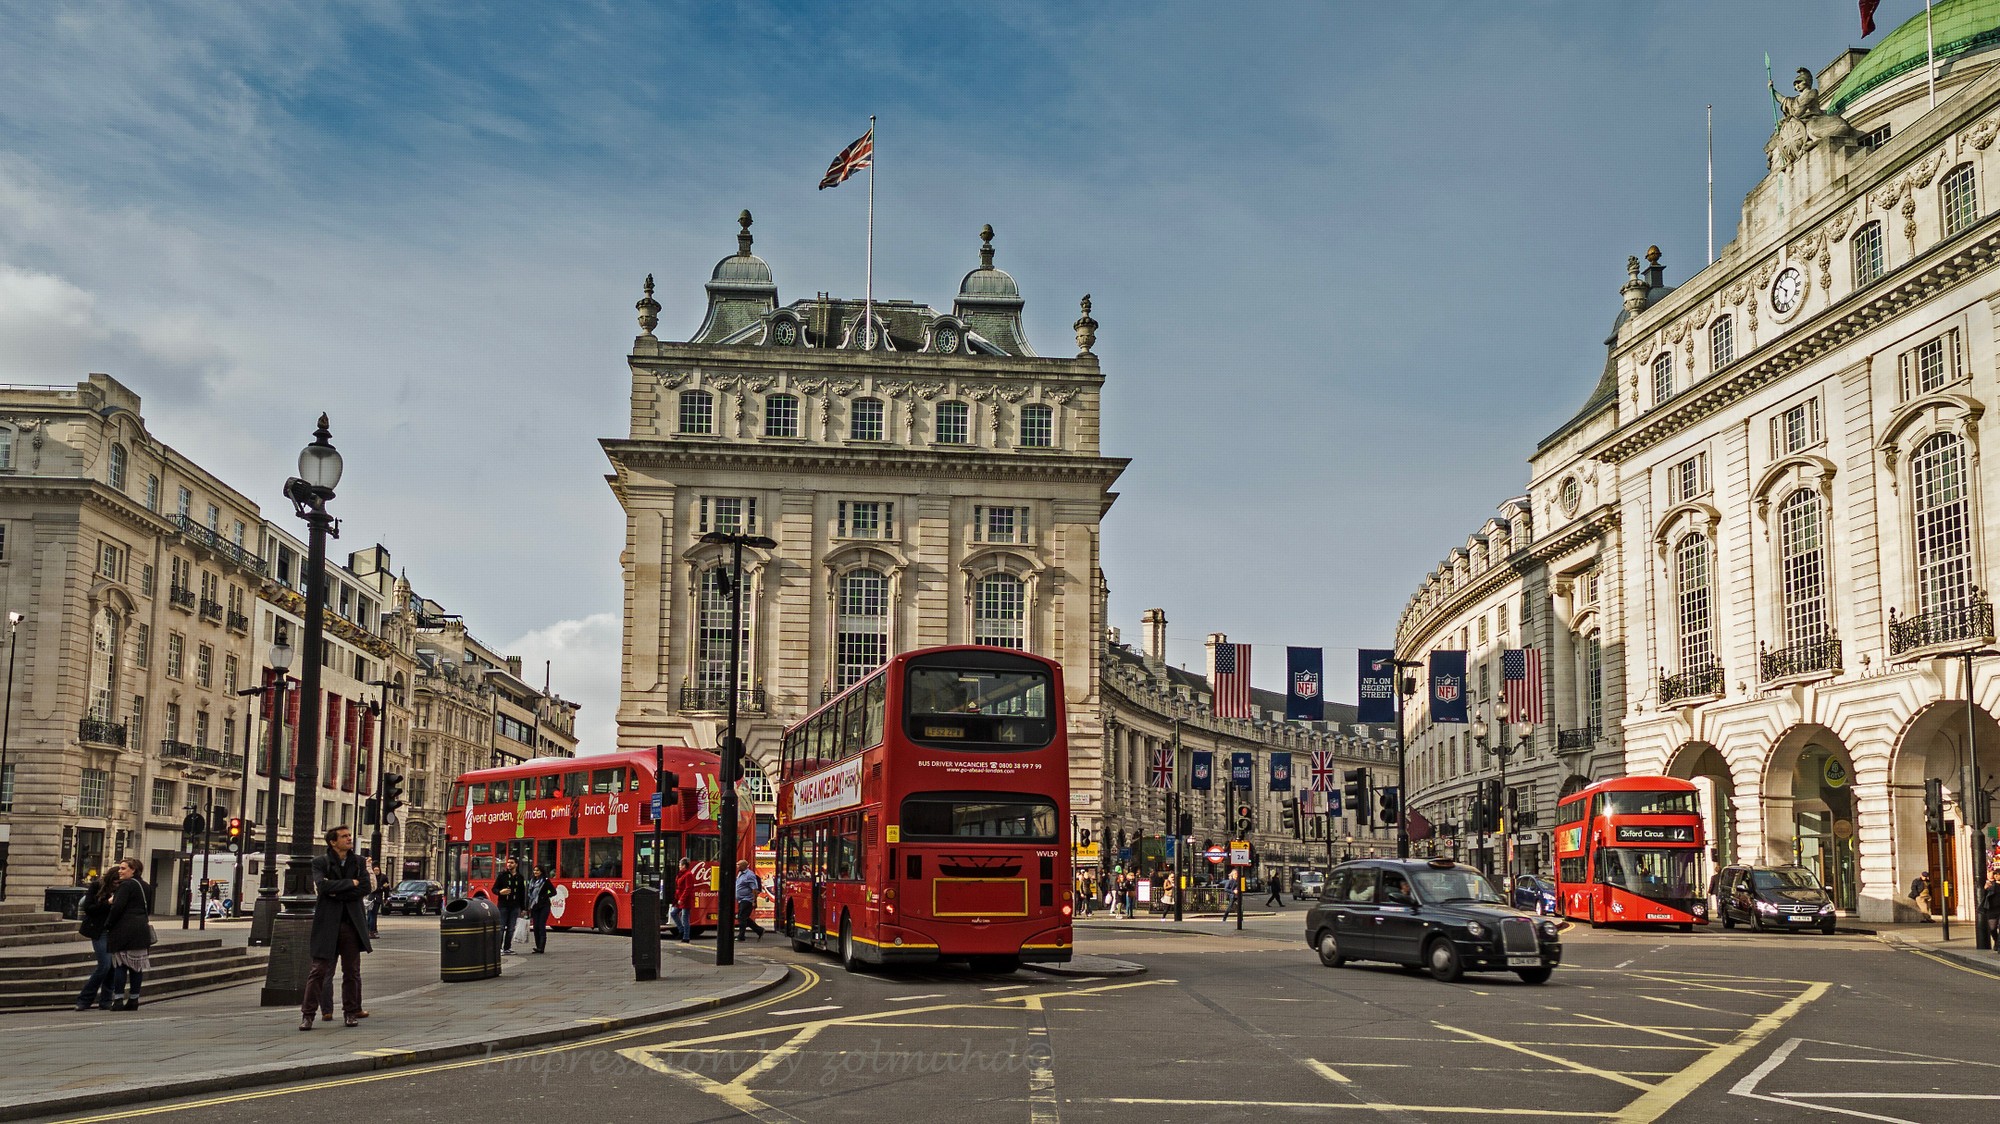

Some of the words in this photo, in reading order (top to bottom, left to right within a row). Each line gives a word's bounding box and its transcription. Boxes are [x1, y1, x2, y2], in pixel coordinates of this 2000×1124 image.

[1297, 682, 1315, 695] NFL
[1437, 686, 1457, 698] NFL
[999, 725, 1016, 741] 14
[488, 810, 514, 825] garden,
[584, 801, 606, 816] brick
[1620, 829, 1642, 838] Oxford
[1644, 829, 1664, 838] Circus
[1674, 828, 1685, 840] 12
[571, 879, 625, 889] #choosehappiness
